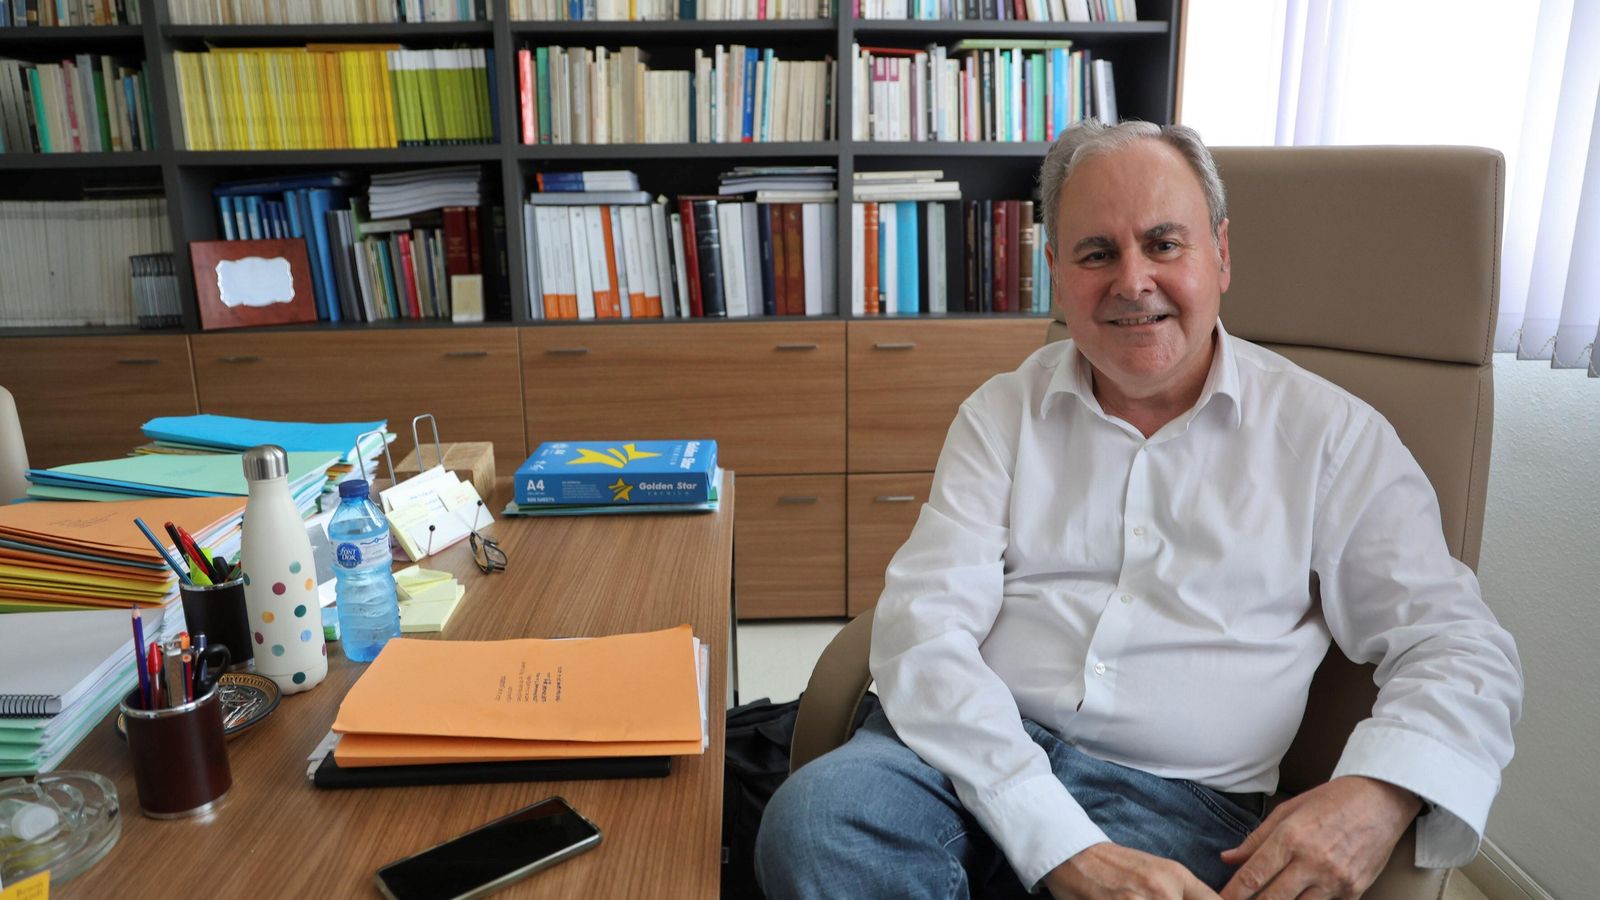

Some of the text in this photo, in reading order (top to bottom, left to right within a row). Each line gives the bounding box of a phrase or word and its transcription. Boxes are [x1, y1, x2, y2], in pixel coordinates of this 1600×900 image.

[527, 479, 545, 491] A4
[639, 481, 697, 490] Golden Star
